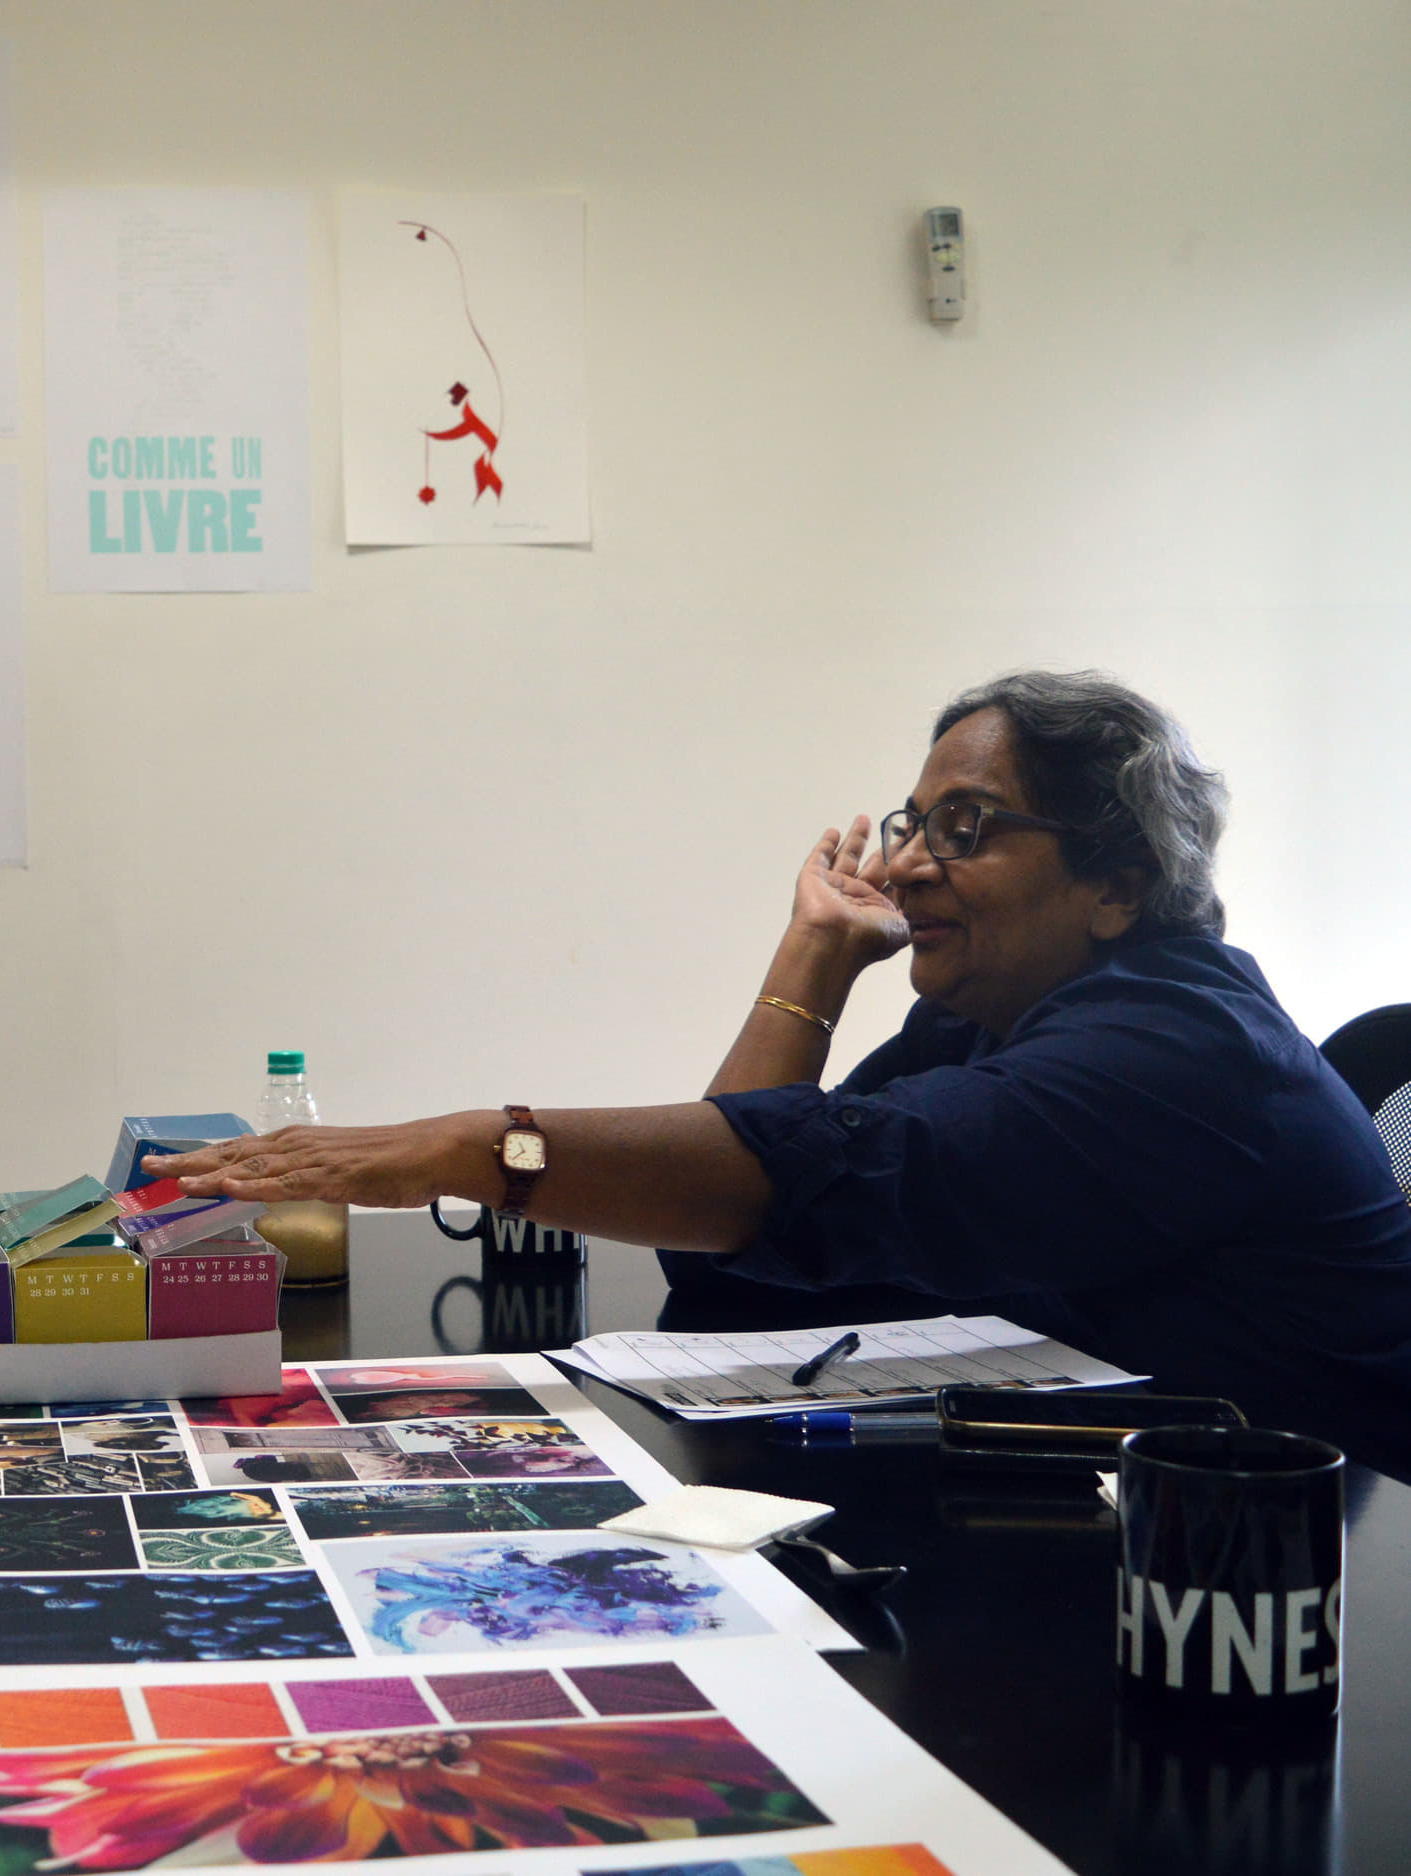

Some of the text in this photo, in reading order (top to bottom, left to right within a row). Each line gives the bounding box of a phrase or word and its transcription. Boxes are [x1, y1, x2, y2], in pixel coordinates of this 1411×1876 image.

[88, 436, 263, 481] COMME UN
[90, 489, 263, 554] LIVRE
[492, 1208, 588, 1253] WH
[27, 1272, 135, 1285] M T W T F S S
[160, 1260, 267, 1272] M T W T F S S
